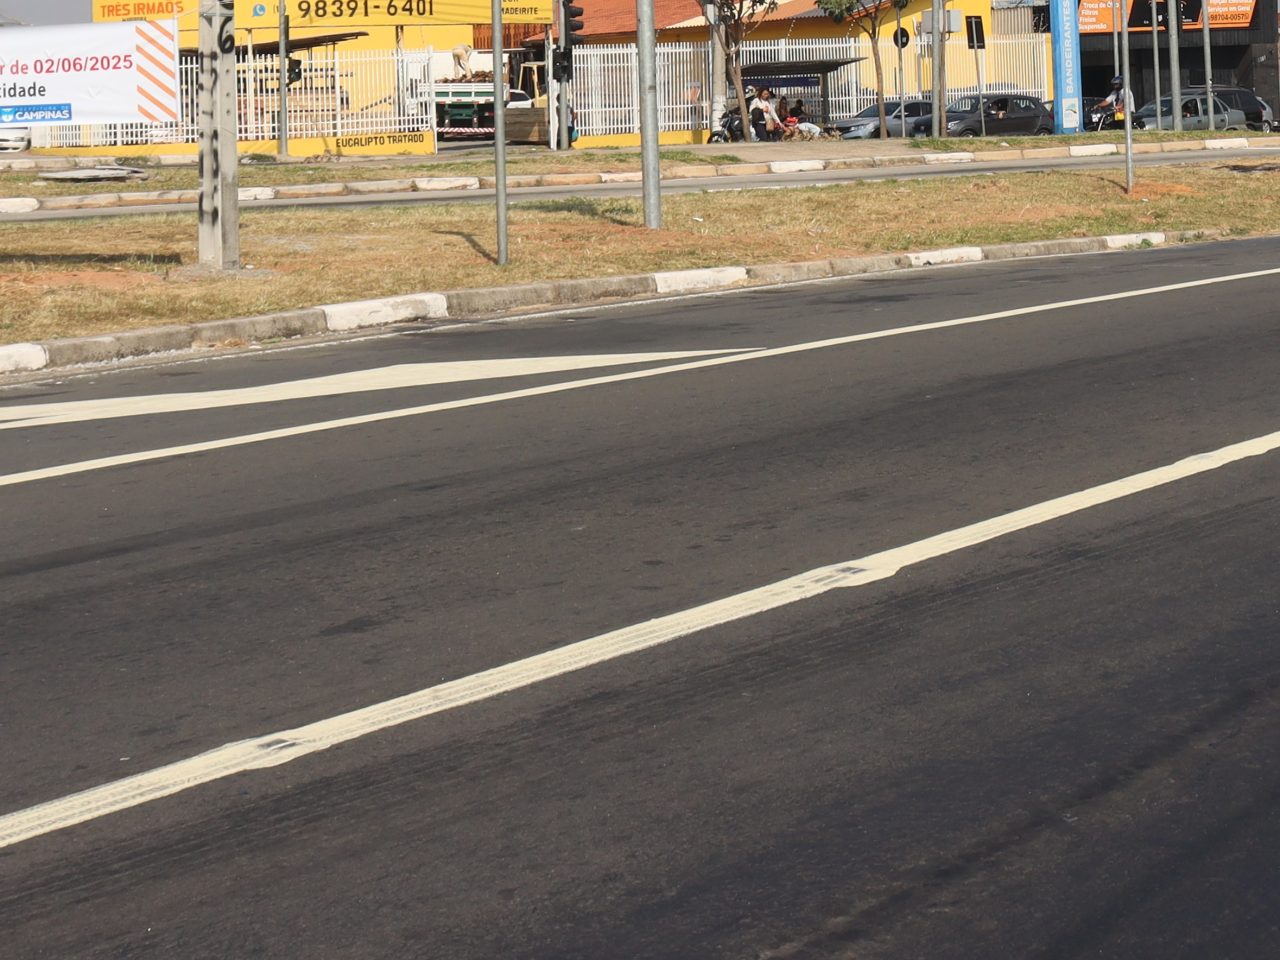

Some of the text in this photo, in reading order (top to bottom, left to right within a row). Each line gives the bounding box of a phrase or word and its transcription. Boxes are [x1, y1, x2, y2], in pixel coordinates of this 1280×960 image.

[101, 1, 130, 18] TRÊS
[1062, 0, 1074, 94] BANDEIRANTES
[10, 60, 29, 76] de
[33, 54, 133, 75] 02/06/2025
[0, 82, 46, 98] idade
[15, 110, 70, 120] CAMPINAS
[336, 134, 424, 148] EUCALIPTO TRATADO
